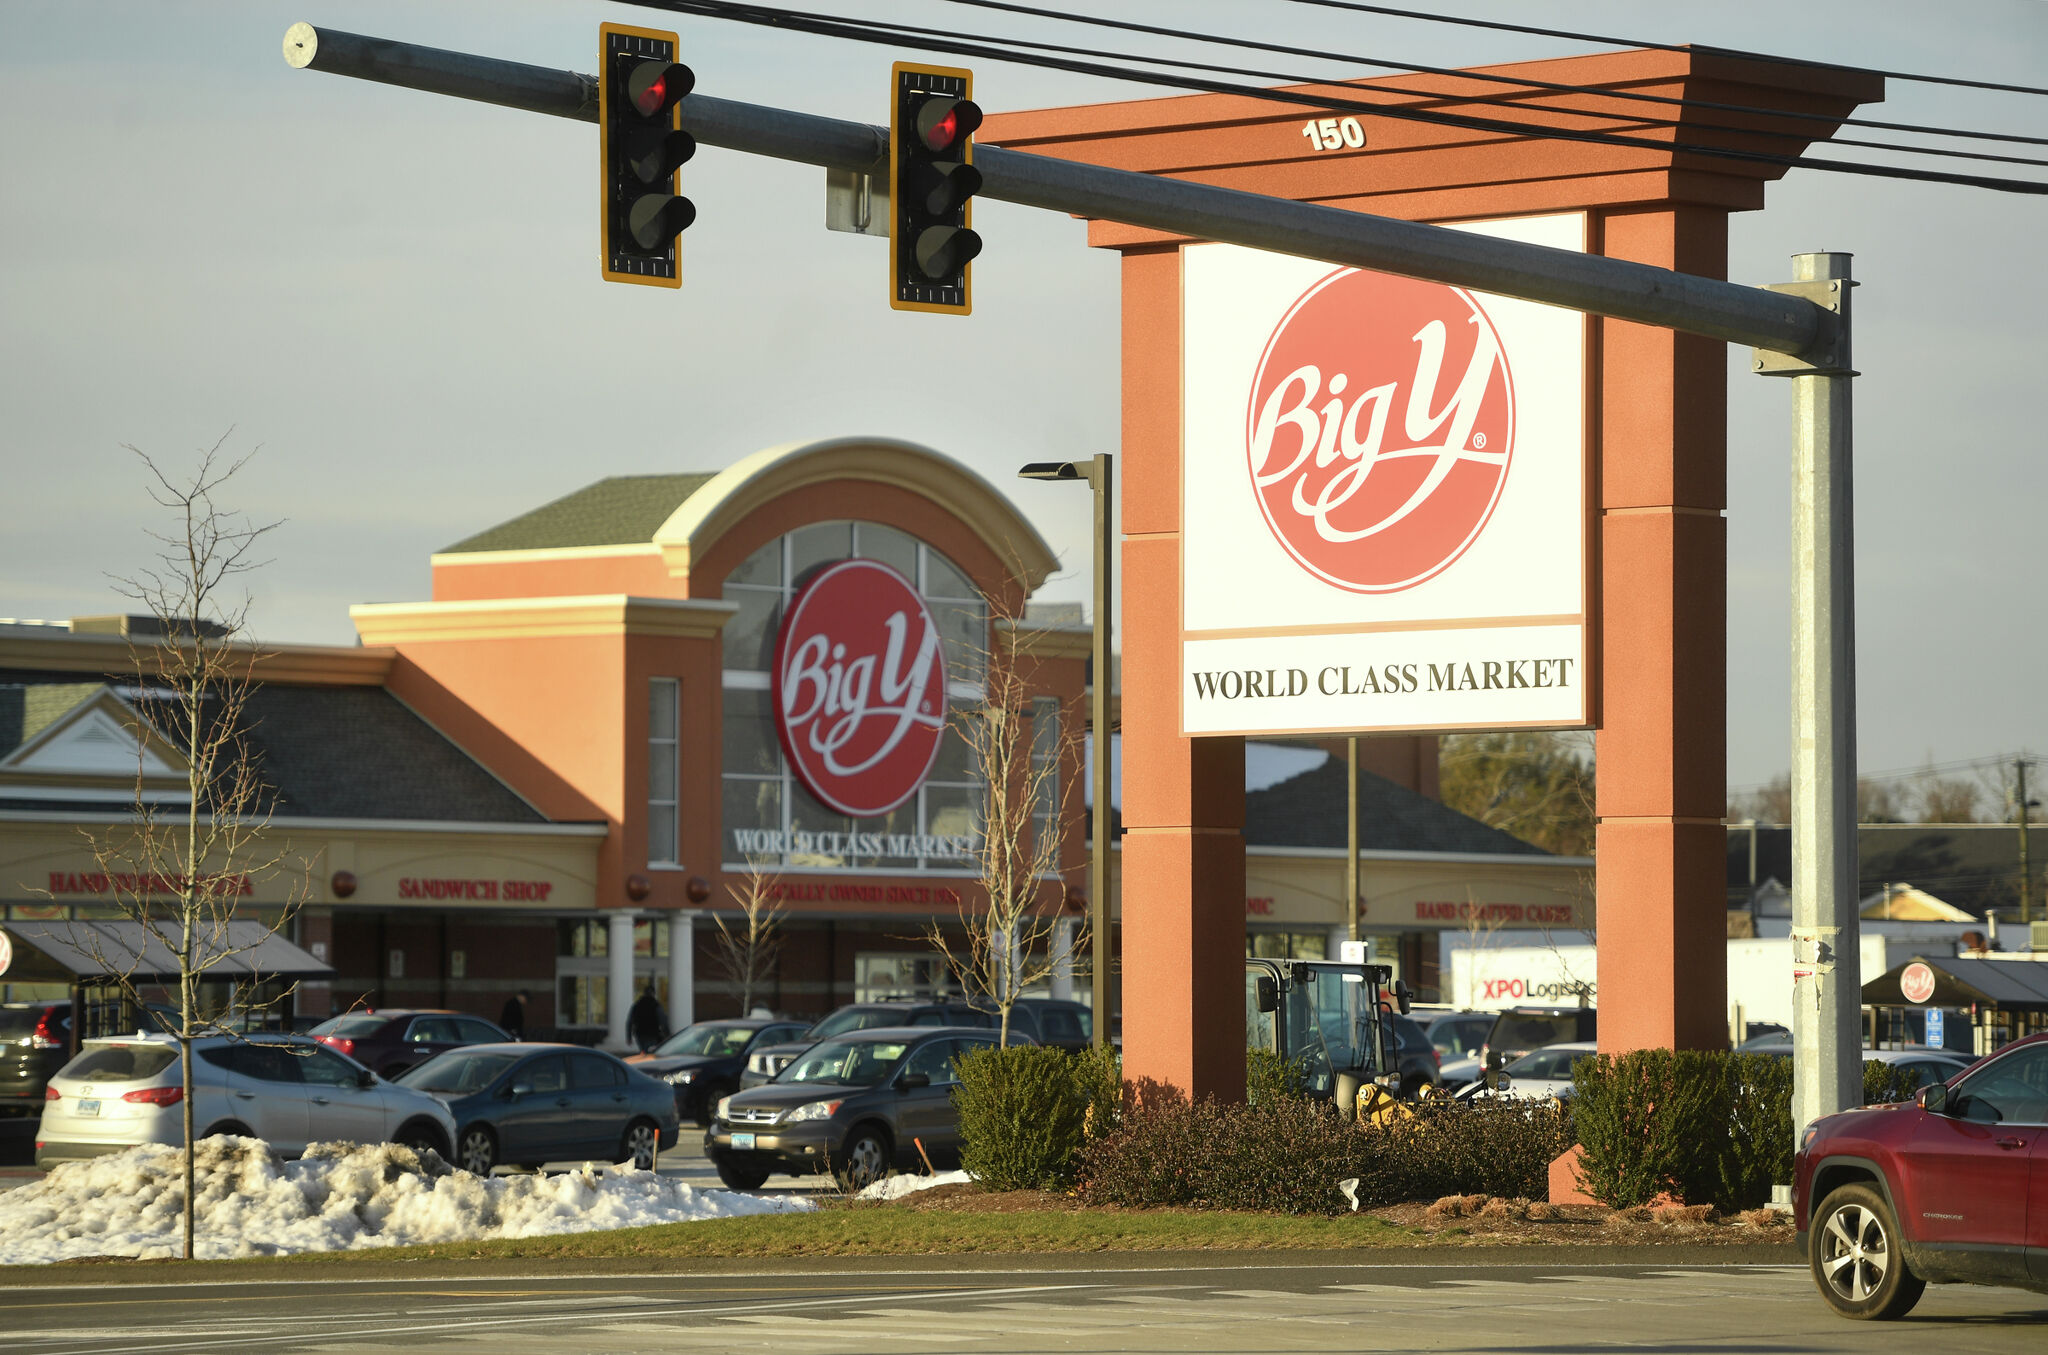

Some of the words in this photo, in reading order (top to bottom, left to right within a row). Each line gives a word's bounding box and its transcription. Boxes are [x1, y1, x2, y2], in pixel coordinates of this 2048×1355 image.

[1302, 117, 1366, 151] 150
[1253, 365, 1398, 516] Big
[784, 633, 877, 753] Big
[1192, 668, 1308, 702] WORLD
[1317, 662, 1419, 697] CLASS
[1426, 657, 1575, 692] MARKET
[733, 828, 812, 855] WORLD
[816, 831, 884, 857] CLASS
[886, 833, 978, 860] MARKET
[49, 871, 111, 894] HAND
[399, 877, 498, 900] SANDWICH
[502, 880, 553, 902] SHOP
[829, 885, 885, 902] OWNED
[887, 886, 930, 904] SINCE
[1416, 902, 1456, 920] HAND
[1483, 978, 1523, 999] XPO
